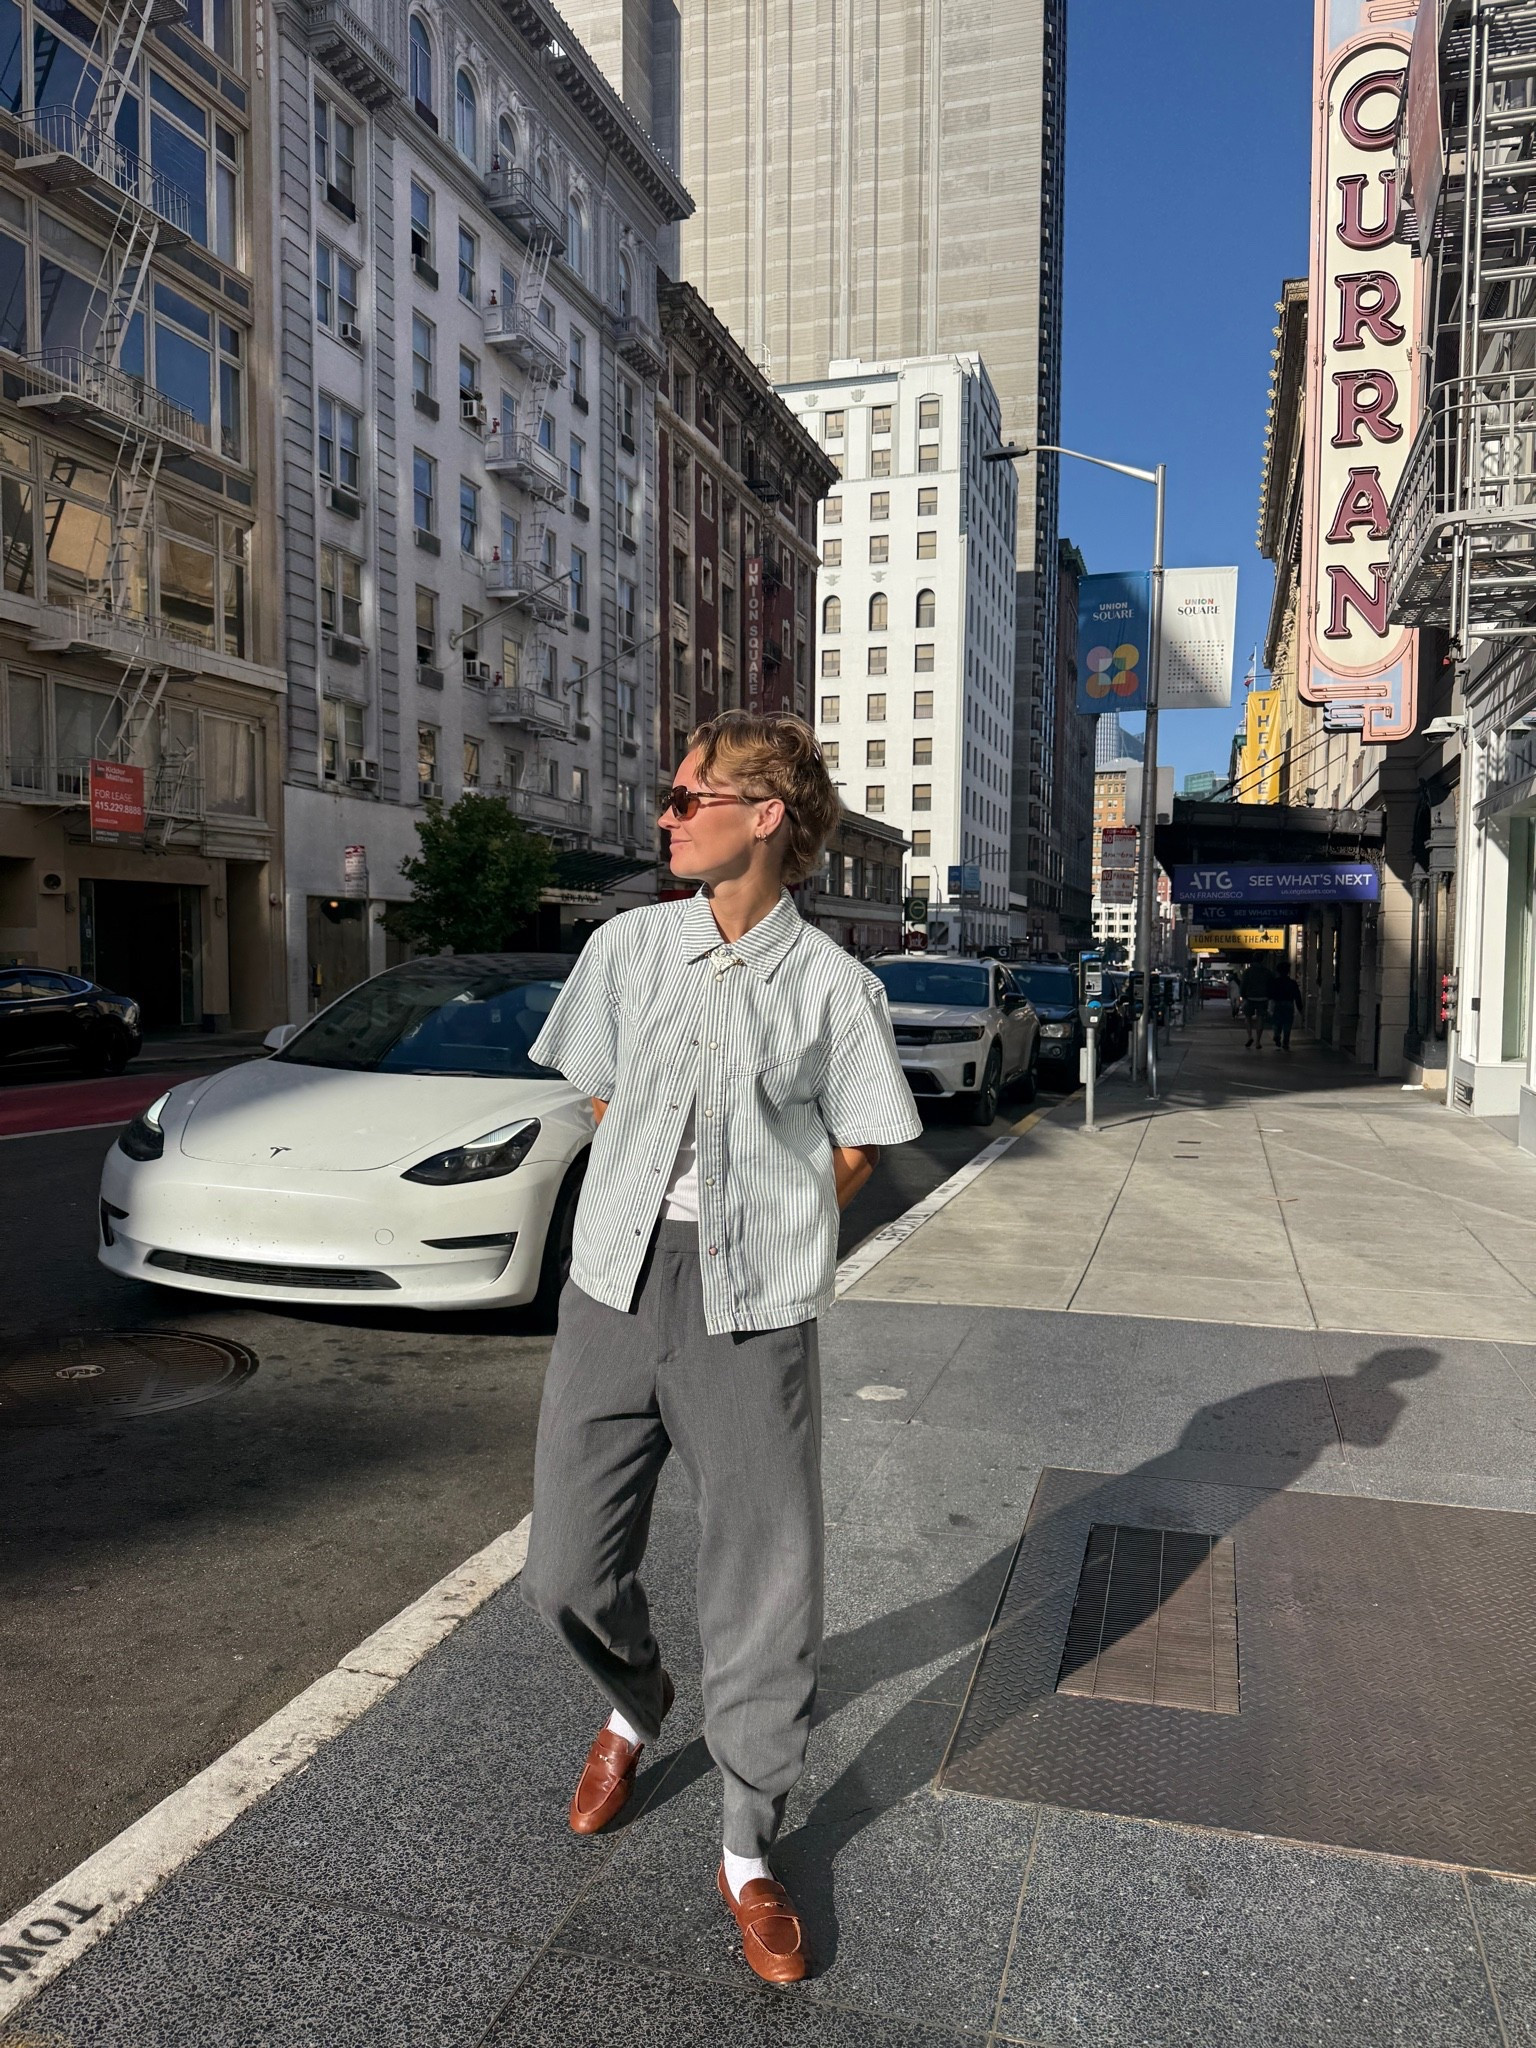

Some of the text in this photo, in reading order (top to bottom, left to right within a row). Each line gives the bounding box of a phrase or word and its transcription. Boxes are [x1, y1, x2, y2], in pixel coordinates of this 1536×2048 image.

[1326, 68, 1406, 640] CURRAN
[748, 563, 759, 621] UNION
[1099, 602, 1128, 611] UNION
[1184, 598, 1214, 606] UNION
[1092, 608, 1135, 622] SQUARE
[1177, 604, 1221, 618] SQUARE
[748, 625, 759, 695] SQUARE
[94, 789, 133, 802] FOR LEASE
[94, 801, 142, 815] 415.229.8888
[1103, 834, 1113, 843] NO
[1102, 871, 1112, 880] NO
[1190, 871, 1233, 889] ATG
[1249, 873, 1373, 887] SEE WHAT'S NEXT
[1179, 891, 1244, 900] SAN FRANCISCO
[1202, 906, 1227, 918] ATG
[1234, 909, 1247, 917] SEE
